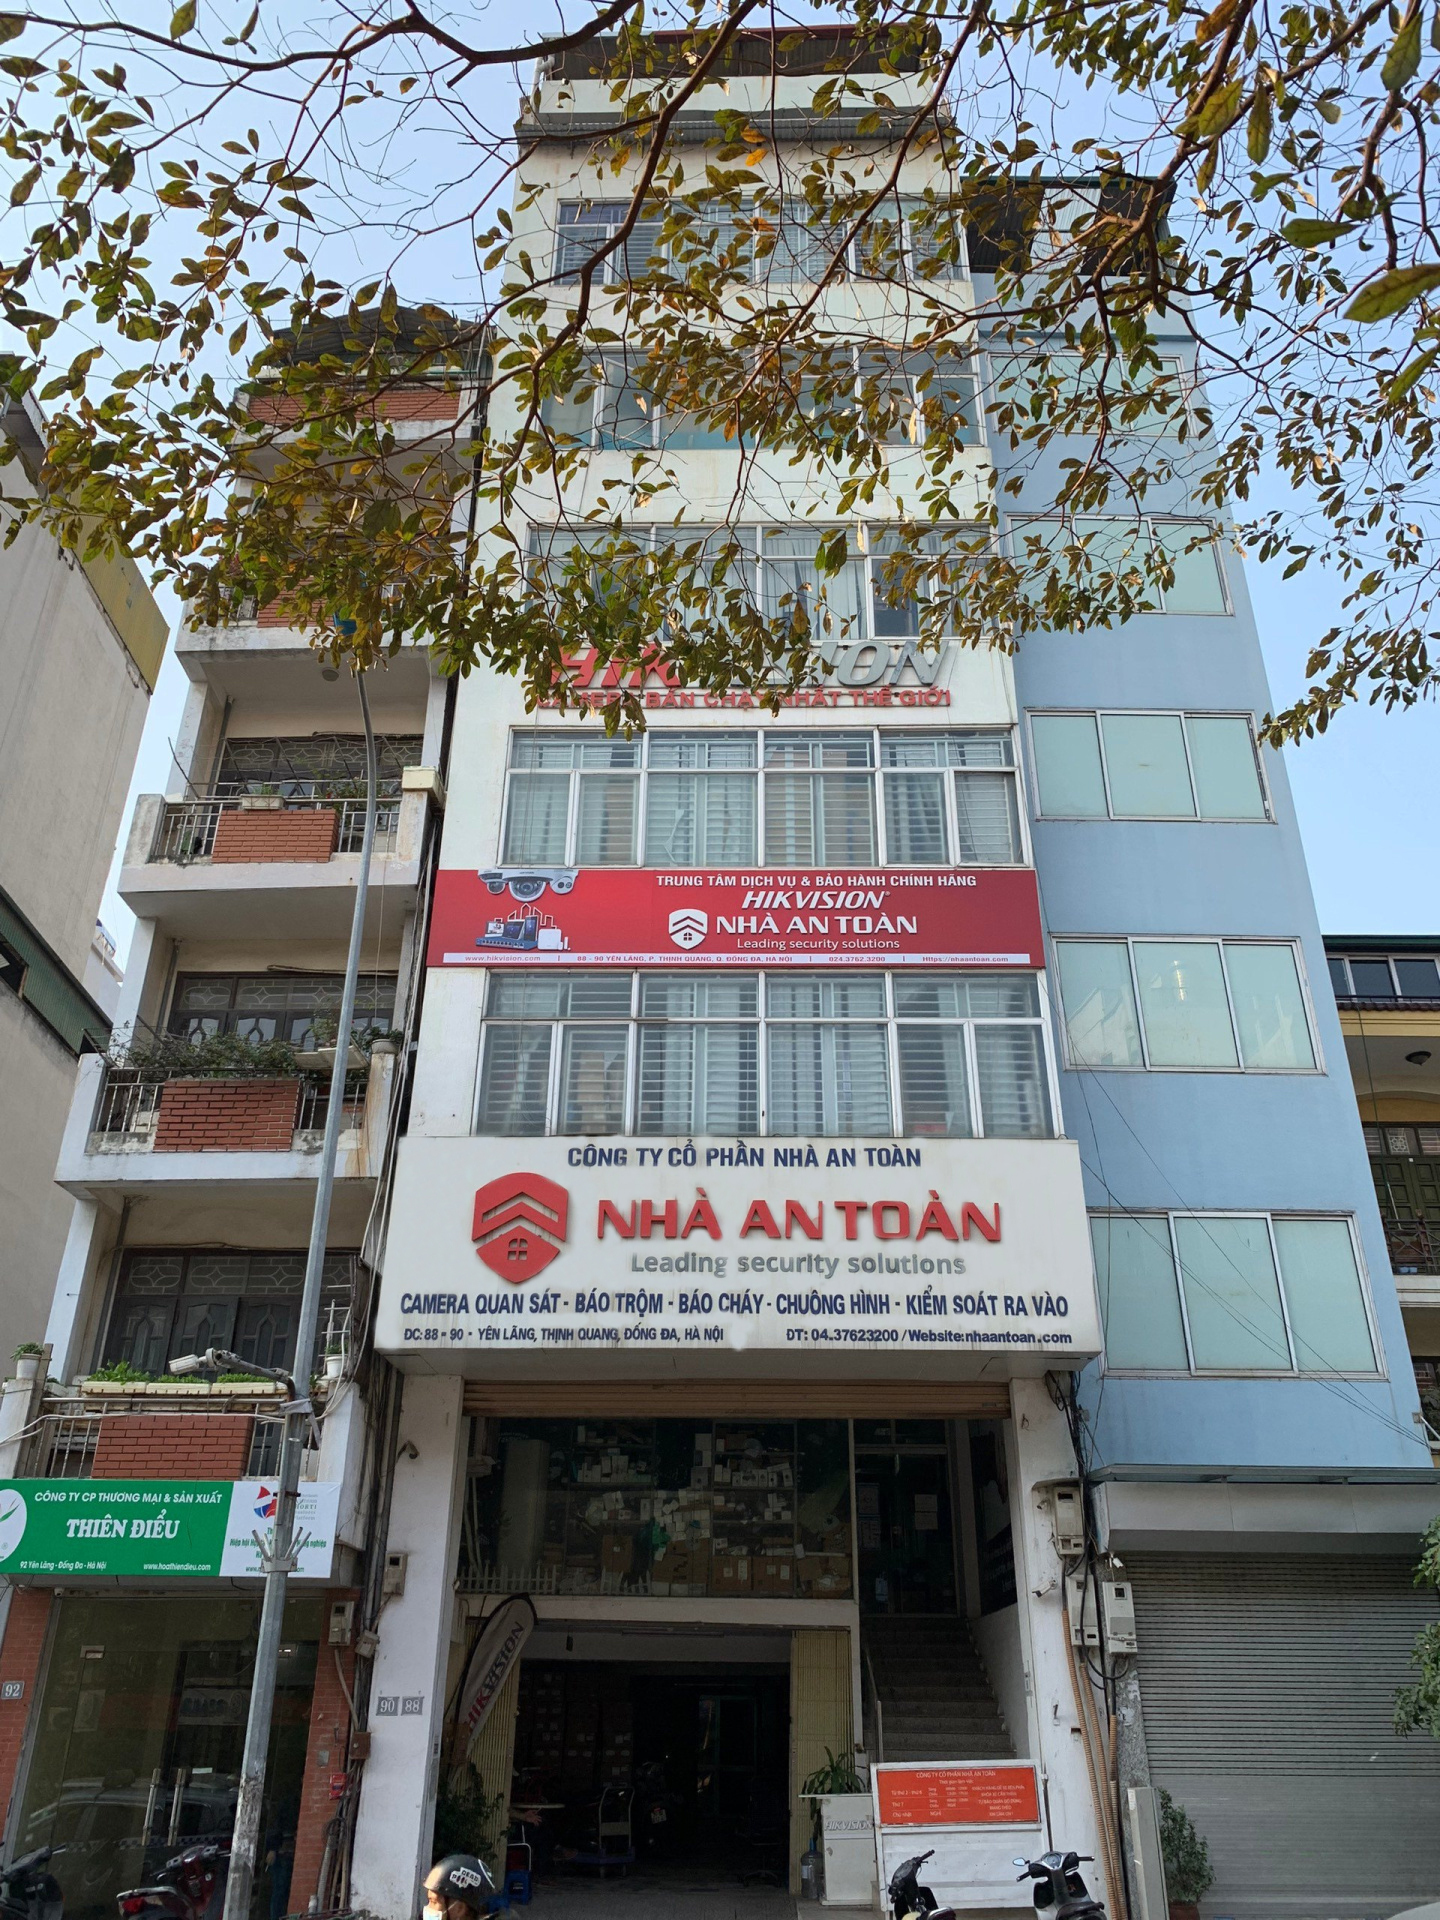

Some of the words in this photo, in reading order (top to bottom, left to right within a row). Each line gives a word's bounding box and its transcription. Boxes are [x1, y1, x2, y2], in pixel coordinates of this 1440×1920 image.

[646, 686, 695, 708] BÁN
[849, 683, 893, 706] THẾ
[900, 685, 951, 707] GIỚI
[657, 876, 702, 886] TRUNG
[708, 874, 736, 885] TÂM
[741, 876, 773, 888] DỊCH
[778, 876, 795, 888] VỤ
[801, 876, 810, 886] &
[816, 873, 842, 886] BẢO
[848, 874, 885, 886] HÀNH
[891, 874, 933, 886] CHÍNH
[938, 874, 976, 886] HÃNG
[717, 913, 779, 933] NHÀ
[786, 916, 828, 933] AN
[834, 913, 917, 933] TOÀN
[737, 938, 786, 950] Leading
[789, 938, 839, 951] security
[842, 939, 899, 948] solutions
[568, 1144, 627, 1167] CÔNG
[636, 1148, 662, 1166] TY
[668, 1138, 697, 1167] CỔ
[706, 1139, 764, 1167] PHẦN
[774, 1144, 818, 1167] NHÀ
[826, 1148, 856, 1167] AN
[864, 1144, 920, 1167] TOÀN
[597, 1186, 724, 1242] NHÀ
[738, 1199, 824, 1241] AN
[833, 1189, 1001, 1243] TOÀN
[632, 1252, 726, 1278] Leading
[738, 1254, 839, 1279] security
[848, 1253, 965, 1274] solutions
[401, 1293, 469, 1314] CAMERA
[476, 1294, 524, 1314] QUAN
[530, 1288, 561, 1313] SÁT
[575, 1288, 610, 1313] BÁO
[615, 1288, 663, 1317] TRỘM
[679, 1289, 712, 1313] BÁO
[719, 1289, 763, 1314] CHÁY
[776, 1290, 845, 1315] CHUÔNG
[850, 1289, 890, 1314] HÌNH
[906, 1285, 947, 1315] KIỂM
[953, 1291, 997, 1315] SOÁT
[1004, 1296, 1028, 1316] RA
[1032, 1291, 1068, 1317] VÀO
[450, 1328, 463, 1341] 90
[478, 1325, 500, 1340] YÊN
[503, 1325, 537, 1342] LÃNG,
[541, 1328, 574, 1343] THỊNH
[578, 1328, 620, 1345] QUANG,
[624, 1322, 656, 1340] ĐỐNG
[660, 1328, 680, 1342] ĐA,
[685, 1326, 700, 1340] HÀ
[704, 1325, 723, 1342] NỘI
[787, 1329, 808, 1340] ĐT:
[811, 1329, 898, 1342] 04.37623200
[35, 1490, 66, 1501] CÔNG
[69, 1493, 79, 1501] TY
[82, 1493, 96, 1501] CP
[99, 1492, 140, 1502] THƯƠNG
[142, 1493, 162, 1505] MẠI
[164, 1494, 170, 1502] &
[173, 1491, 193, 1503] SẢN
[196, 1491, 222, 1503] XUẤT
[67, 1514, 127, 1537] THIÊN
[130, 1509, 180, 1538] ĐIỂU
[19, 1560, 28, 1569] 92
[28, 1561, 39, 1569] Yên
[6, 1684, 20, 1697] 92
[380, 1700, 395, 1712] 90
[405, 1700, 419, 1712] 88
